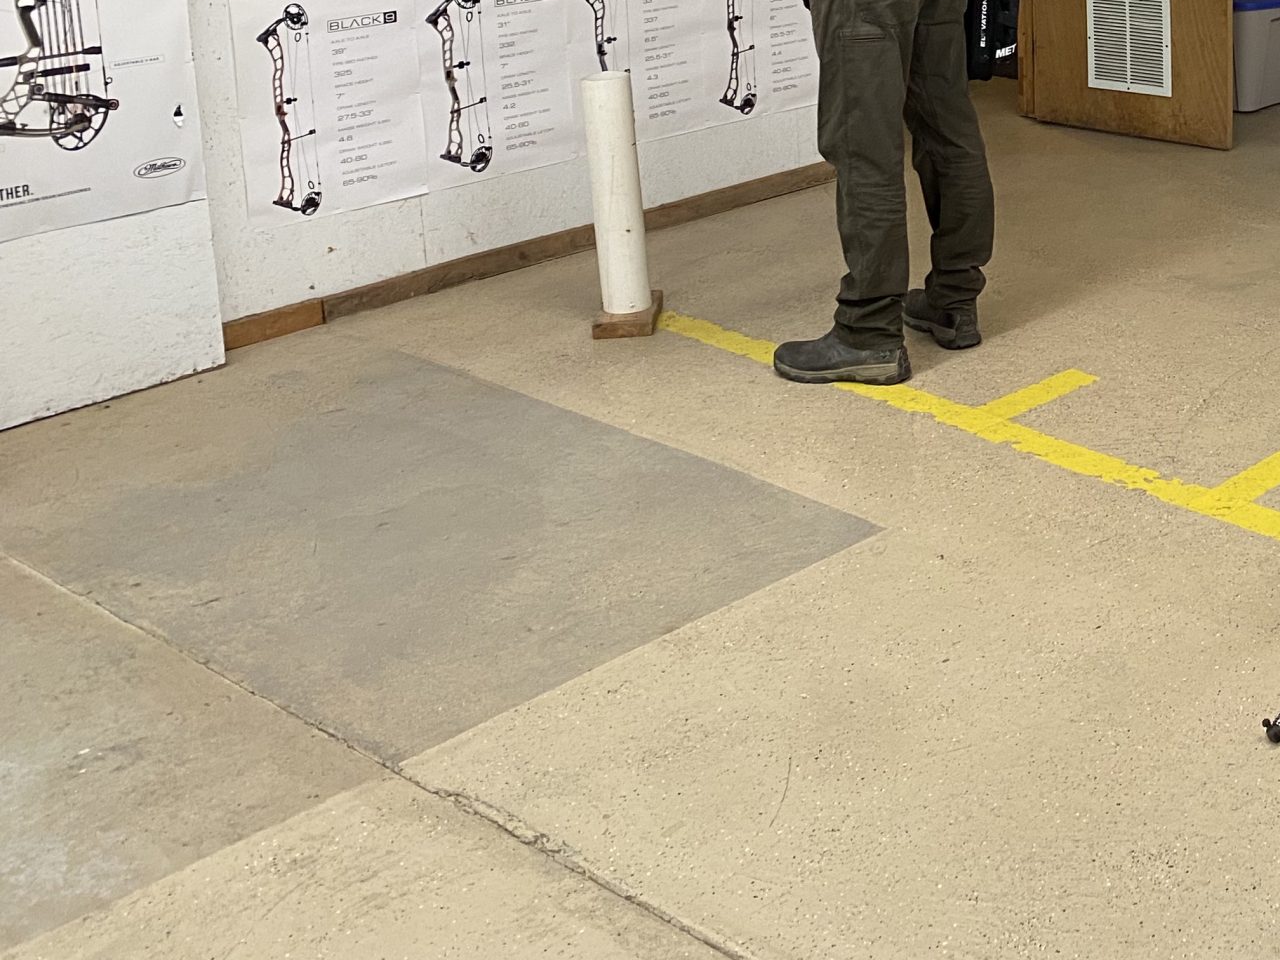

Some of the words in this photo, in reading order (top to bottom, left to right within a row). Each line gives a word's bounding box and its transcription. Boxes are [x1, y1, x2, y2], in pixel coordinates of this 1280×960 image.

[329, 14, 381, 31] BLACK
[384, 11, 396, 23] 9
[995, 43, 1017, 59] MET
[334, 69, 352, 79] 325
[503, 102, 516, 110] 4.2
[0, 183, 34, 201] THER.
